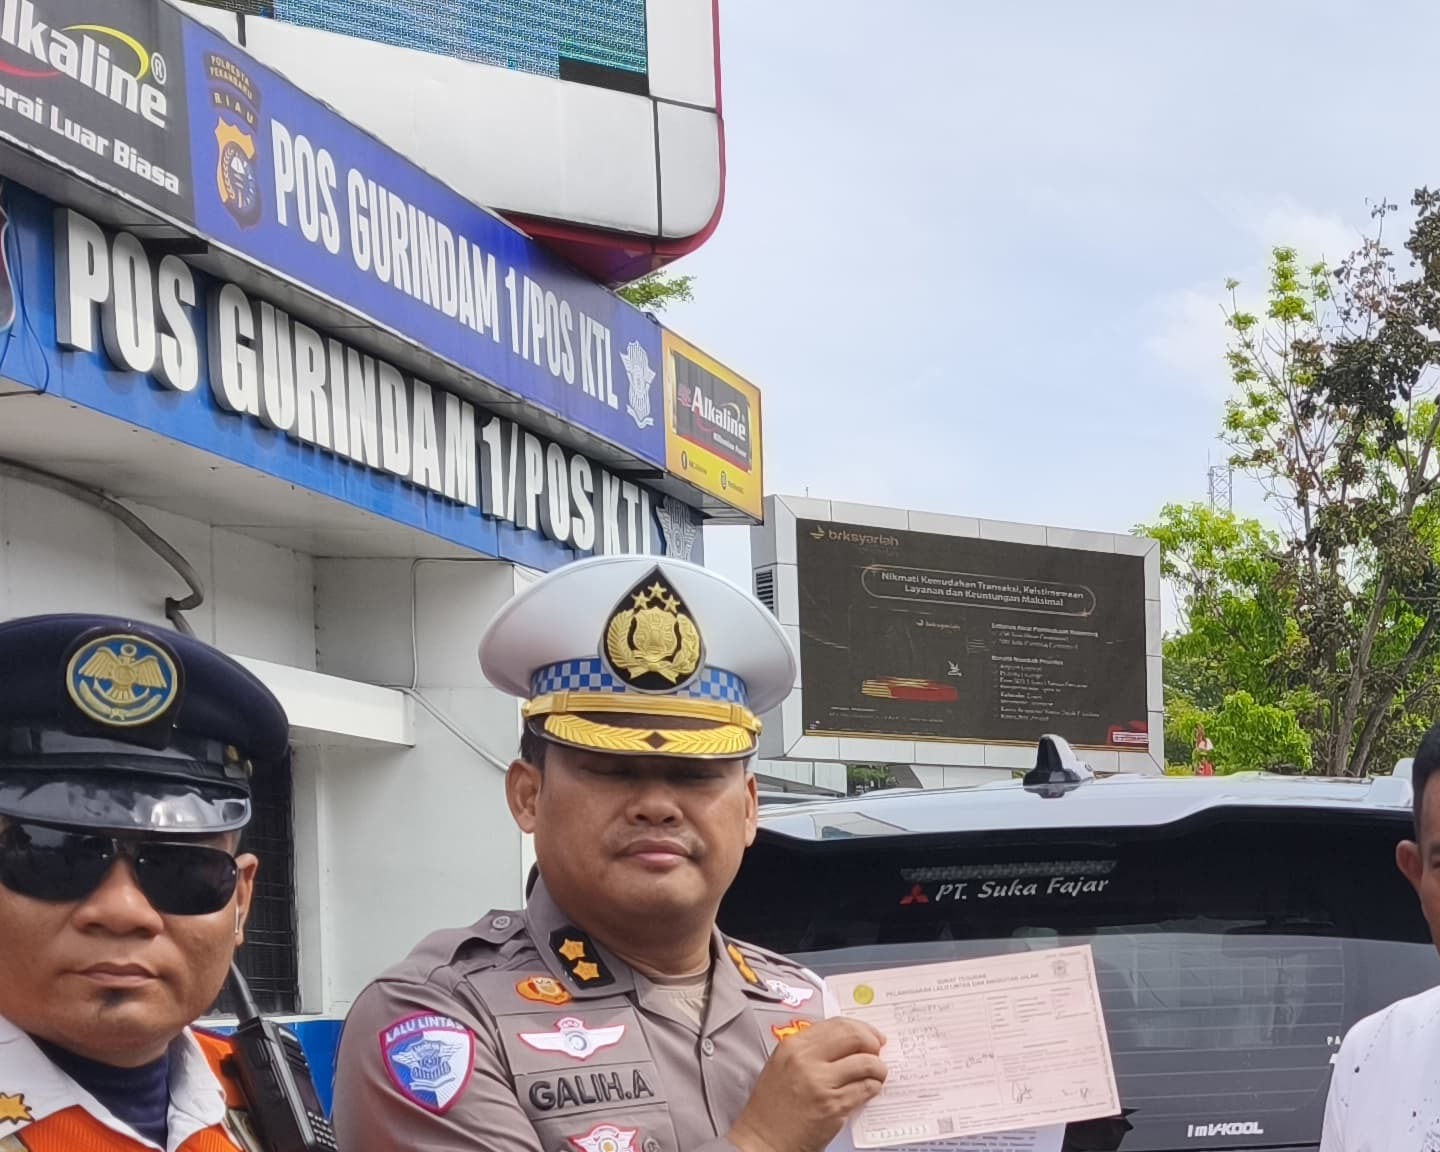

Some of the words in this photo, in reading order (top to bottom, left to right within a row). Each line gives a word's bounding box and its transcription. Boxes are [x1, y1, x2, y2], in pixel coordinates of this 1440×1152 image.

[50, 104, 109, 156] Luar
[113, 138, 179, 195] Biasa
[271, 118, 340, 255] POS
[347, 168, 500, 343] GURINDAM
[505, 266, 575, 388] 1/POS
[579, 310, 619, 410] KTL
[66, 208, 199, 391] POS
[218, 283, 478, 509] GURINDAM
[482, 417, 595, 551] 1/POS
[691, 386, 747, 442] Alkaline
[881, 572, 920, 583] Nikmati
[921, 575, 976, 588] Kemudahan
[904, 584, 944, 596] Layanan
[945, 587, 964, 597] dan
[1021, 595, 1064, 607] Maksimal
[935, 883, 968, 902] PT.
[977, 879, 1038, 899] Suka
[1046, 876, 1109, 898] Fajar
[386, 1018, 416, 1043] LALU
[529, 1069, 655, 1111] GALIH.A
